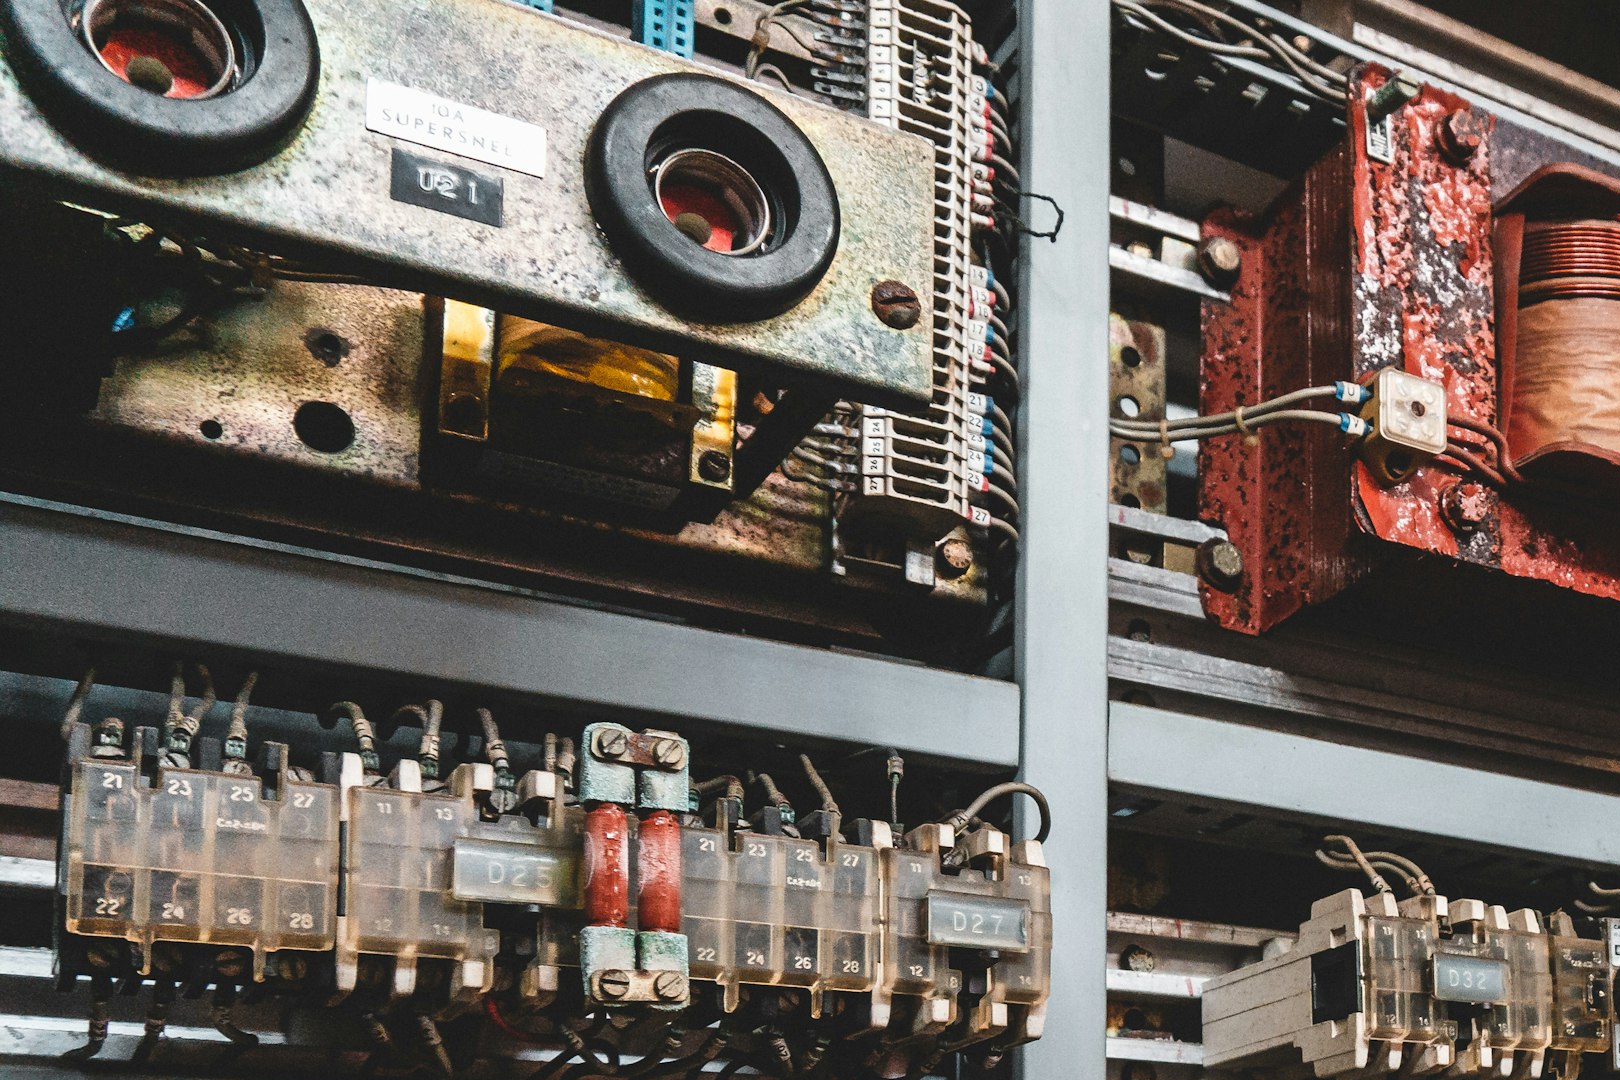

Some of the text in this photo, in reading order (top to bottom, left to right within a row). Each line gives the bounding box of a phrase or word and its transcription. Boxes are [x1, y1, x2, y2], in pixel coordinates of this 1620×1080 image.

[382, 108, 513, 158] SUPERSNEL
[417, 166, 478, 204] U21
[972, 268, 984, 280] 14
[972, 325, 984, 336] 17
[972, 343, 983, 356] 18
[969, 394, 982, 406] 21
[968, 415, 982, 428] 22
[969, 450, 982, 462] 24
[870, 459, 878, 470] 26
[870, 480, 878, 491] 27
[967, 472, 980, 485] 25
[975, 510, 988, 523] 27
[102, 772, 123, 790] 21
[167, 778, 193, 796] 23
[230, 786, 254, 802] 25
[293, 792, 314, 809] 27
[376, 802, 392, 815] 11
[435, 808, 454, 821] 13
[699, 838, 716, 852] 21
[748, 844, 767, 858] 23
[796, 848, 814, 864] 25
[842, 853, 860, 868] 27
[488, 864, 552, 890] D25
[95, 898, 119, 916] 22
[161, 902, 185, 920] 24
[226, 908, 252, 926] 26
[288, 912, 314, 930] 28
[952, 910, 1004, 936] D27
[375, 918, 393, 933] 12
[696, 947, 716, 962] 22
[746, 951, 766, 966] 24
[794, 955, 812, 970] 26
[842, 959, 860, 974] 28
[909, 965, 924, 978] 12
[1449, 968, 1488, 990] D32
